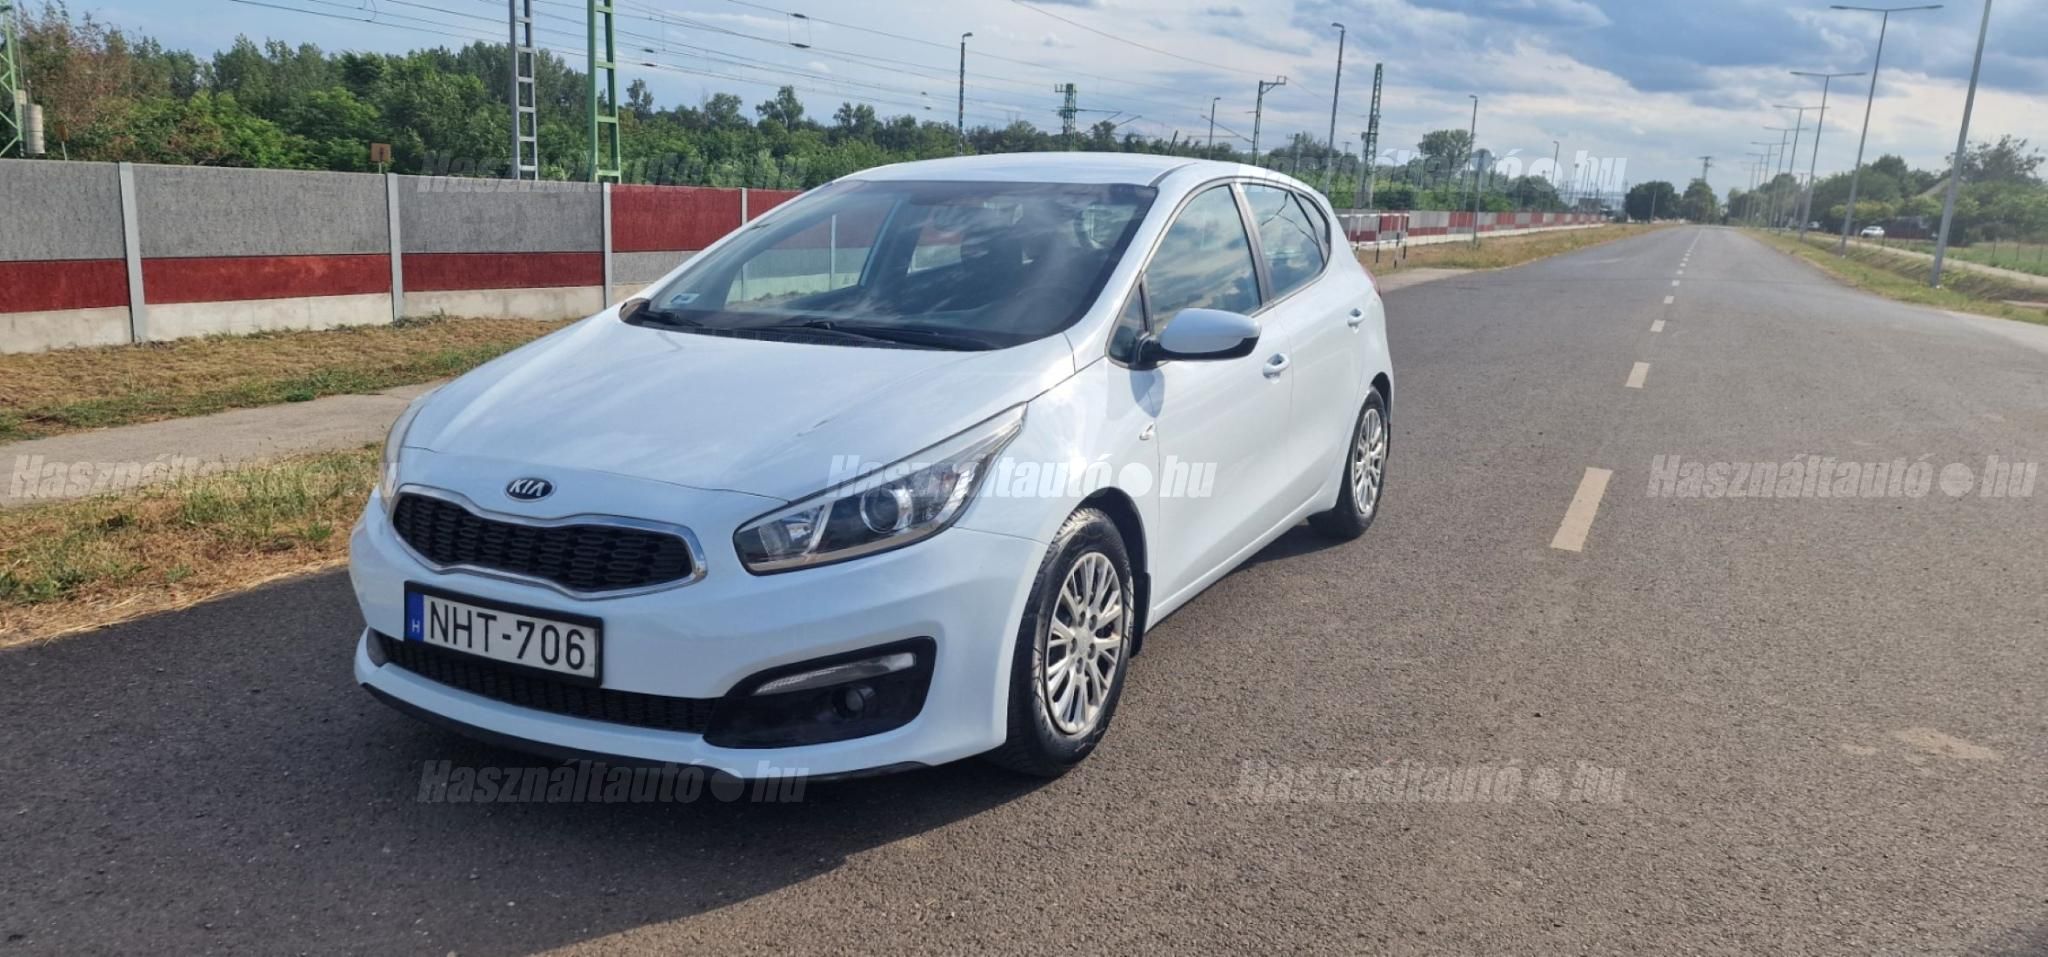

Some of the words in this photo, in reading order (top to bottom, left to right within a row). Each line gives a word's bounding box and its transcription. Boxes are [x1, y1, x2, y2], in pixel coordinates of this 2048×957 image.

[508, 478, 545, 497] KIA
[412, 619, 421, 633] H
[430, 601, 585, 671] NHT-706
